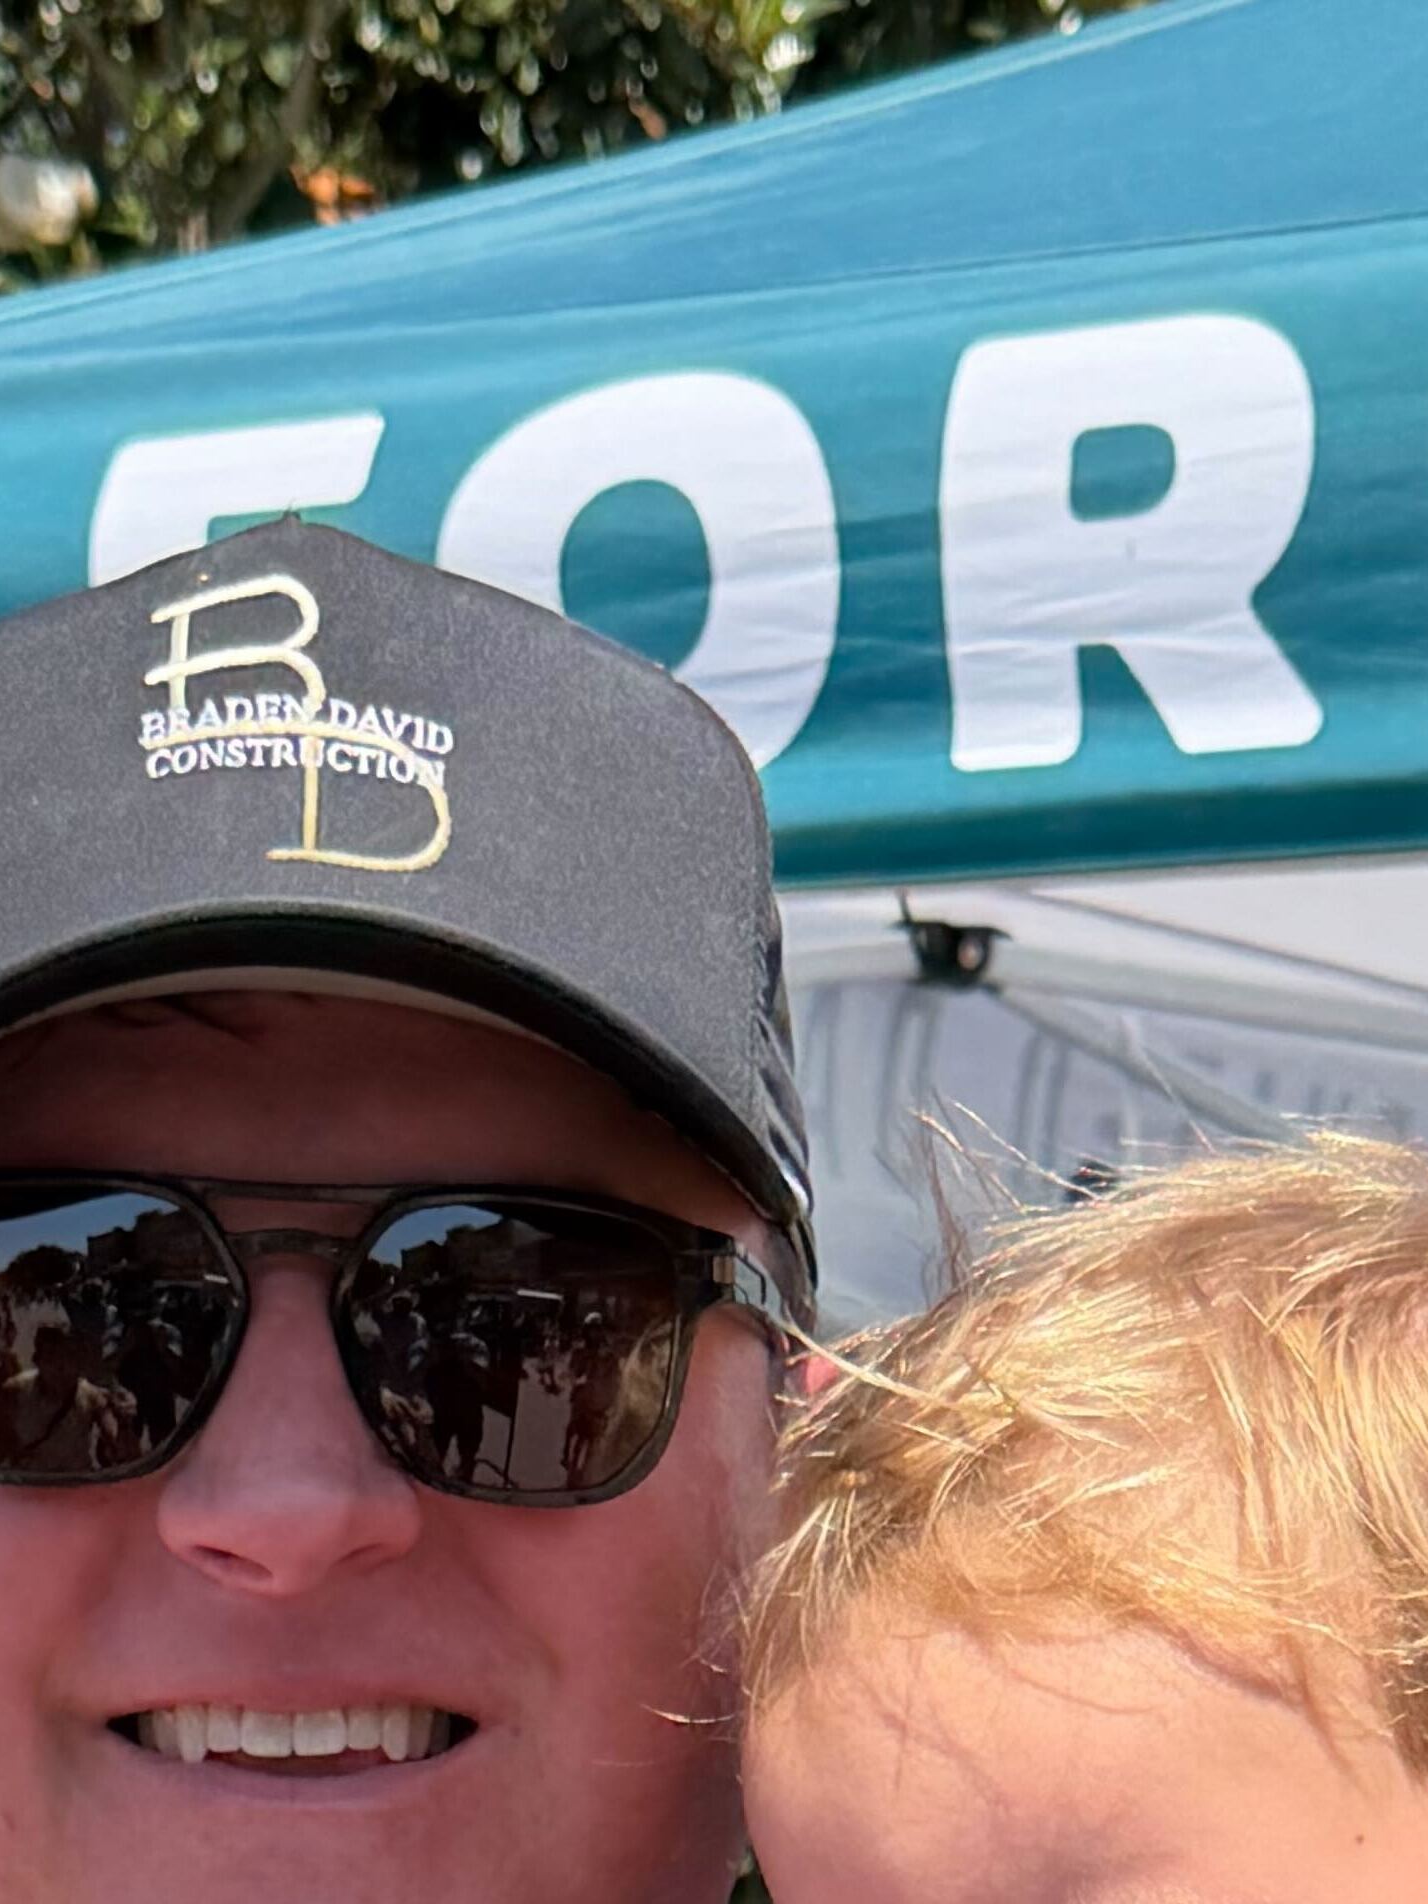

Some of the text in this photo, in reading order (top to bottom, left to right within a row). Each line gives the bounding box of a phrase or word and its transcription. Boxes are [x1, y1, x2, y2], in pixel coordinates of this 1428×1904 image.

[139, 692, 454, 755] BRADEN DAVID
[145, 737, 446, 787] CONSTRUCTION
